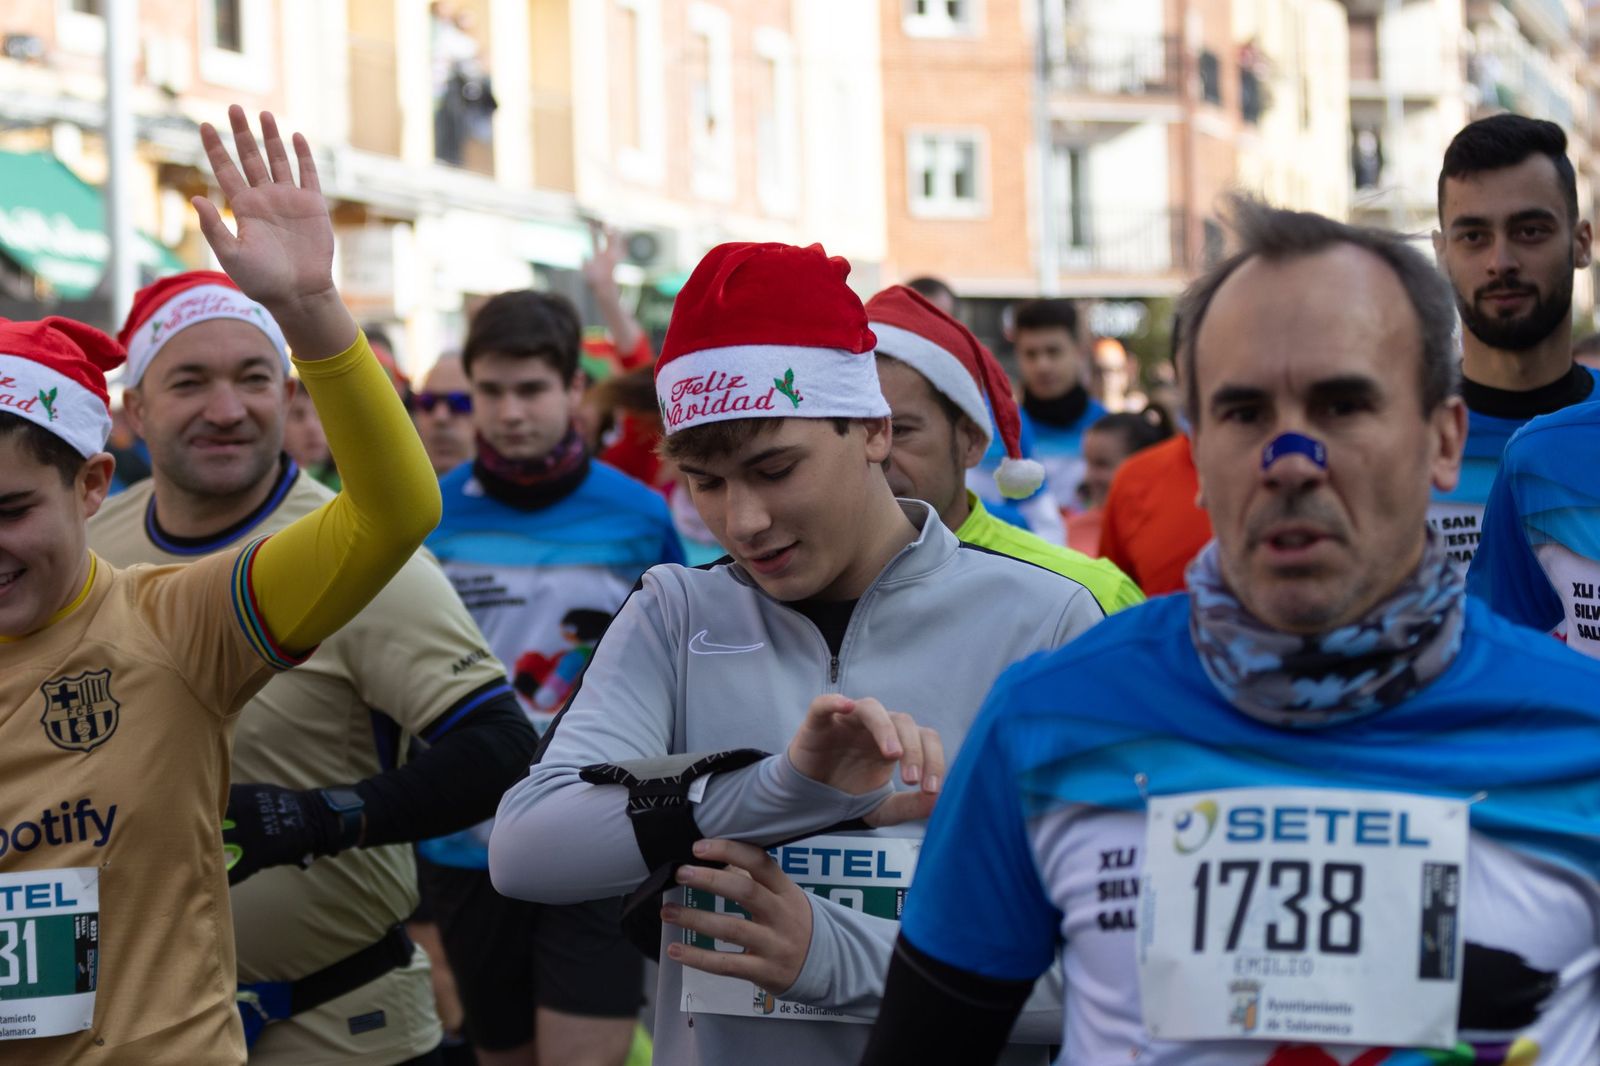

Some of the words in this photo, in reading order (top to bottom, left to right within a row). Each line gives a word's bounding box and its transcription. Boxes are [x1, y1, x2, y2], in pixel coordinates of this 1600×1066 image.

[671, 371, 748, 402] Feliz
[666, 387, 776, 427] Navidad
[1442, 515, 1476, 530] SAN
[1572, 582, 1594, 599] XLI
[1226, 806, 1430, 847] SETEL
[1193, 860, 1364, 954] 1738
[1233, 957, 1314, 978] EMILIO
[780, 1003, 791, 1014] de
